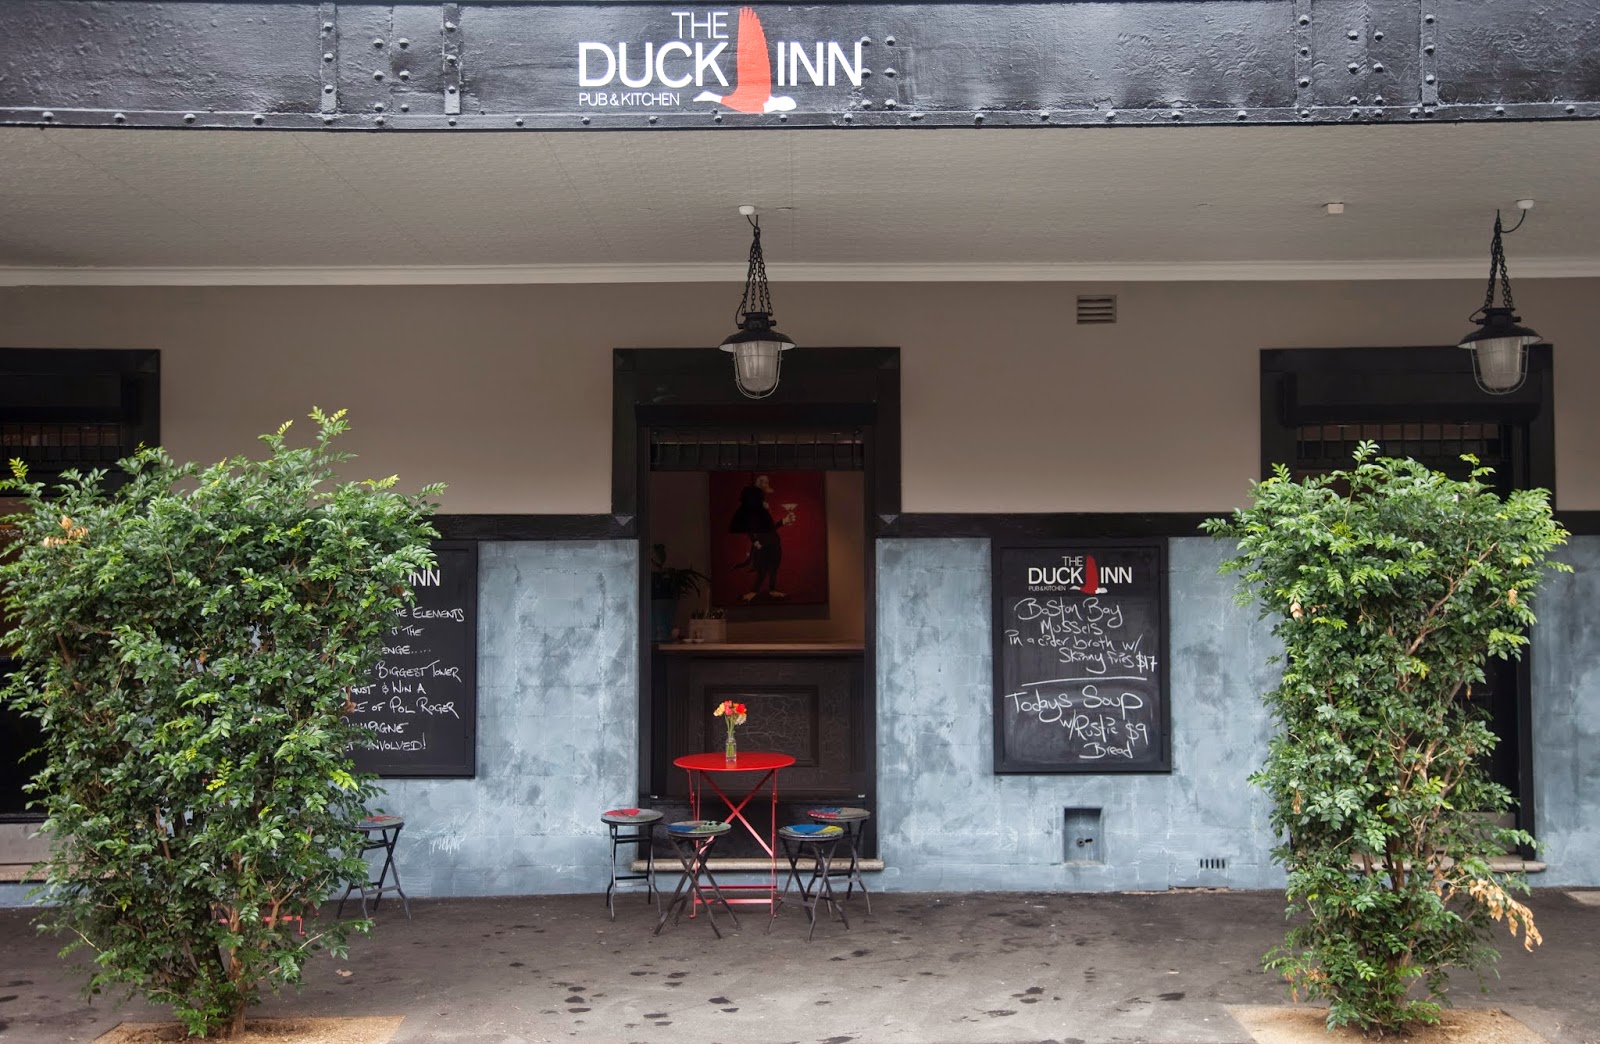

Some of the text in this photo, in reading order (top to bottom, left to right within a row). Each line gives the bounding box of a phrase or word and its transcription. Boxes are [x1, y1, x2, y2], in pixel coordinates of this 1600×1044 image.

[671, 11, 729, 39] THE
[578, 41, 862, 88] DUCK INN
[579, 92, 608, 106] PUB
[621, 92, 680, 106] KITCHEN
[1062, 556, 1083, 567] THE
[1028, 566, 1132, 585] DUCK INN
[1083, 597, 1123, 628] Bay
[402, 625, 425, 637] THE
[1027, 637, 1035, 645] a
[1074, 635, 1116, 651] broth
[1058, 647, 1107, 674] Skinny
[1135, 652, 1158, 673] $17
[392, 680, 412, 694] WIN
[417, 683, 427, 695] A
[389, 696, 416, 714] POL
[416, 696, 460, 719] ROGER
[1125, 720, 1149, 746] $9
[1079, 741, 1133, 759] Bread
